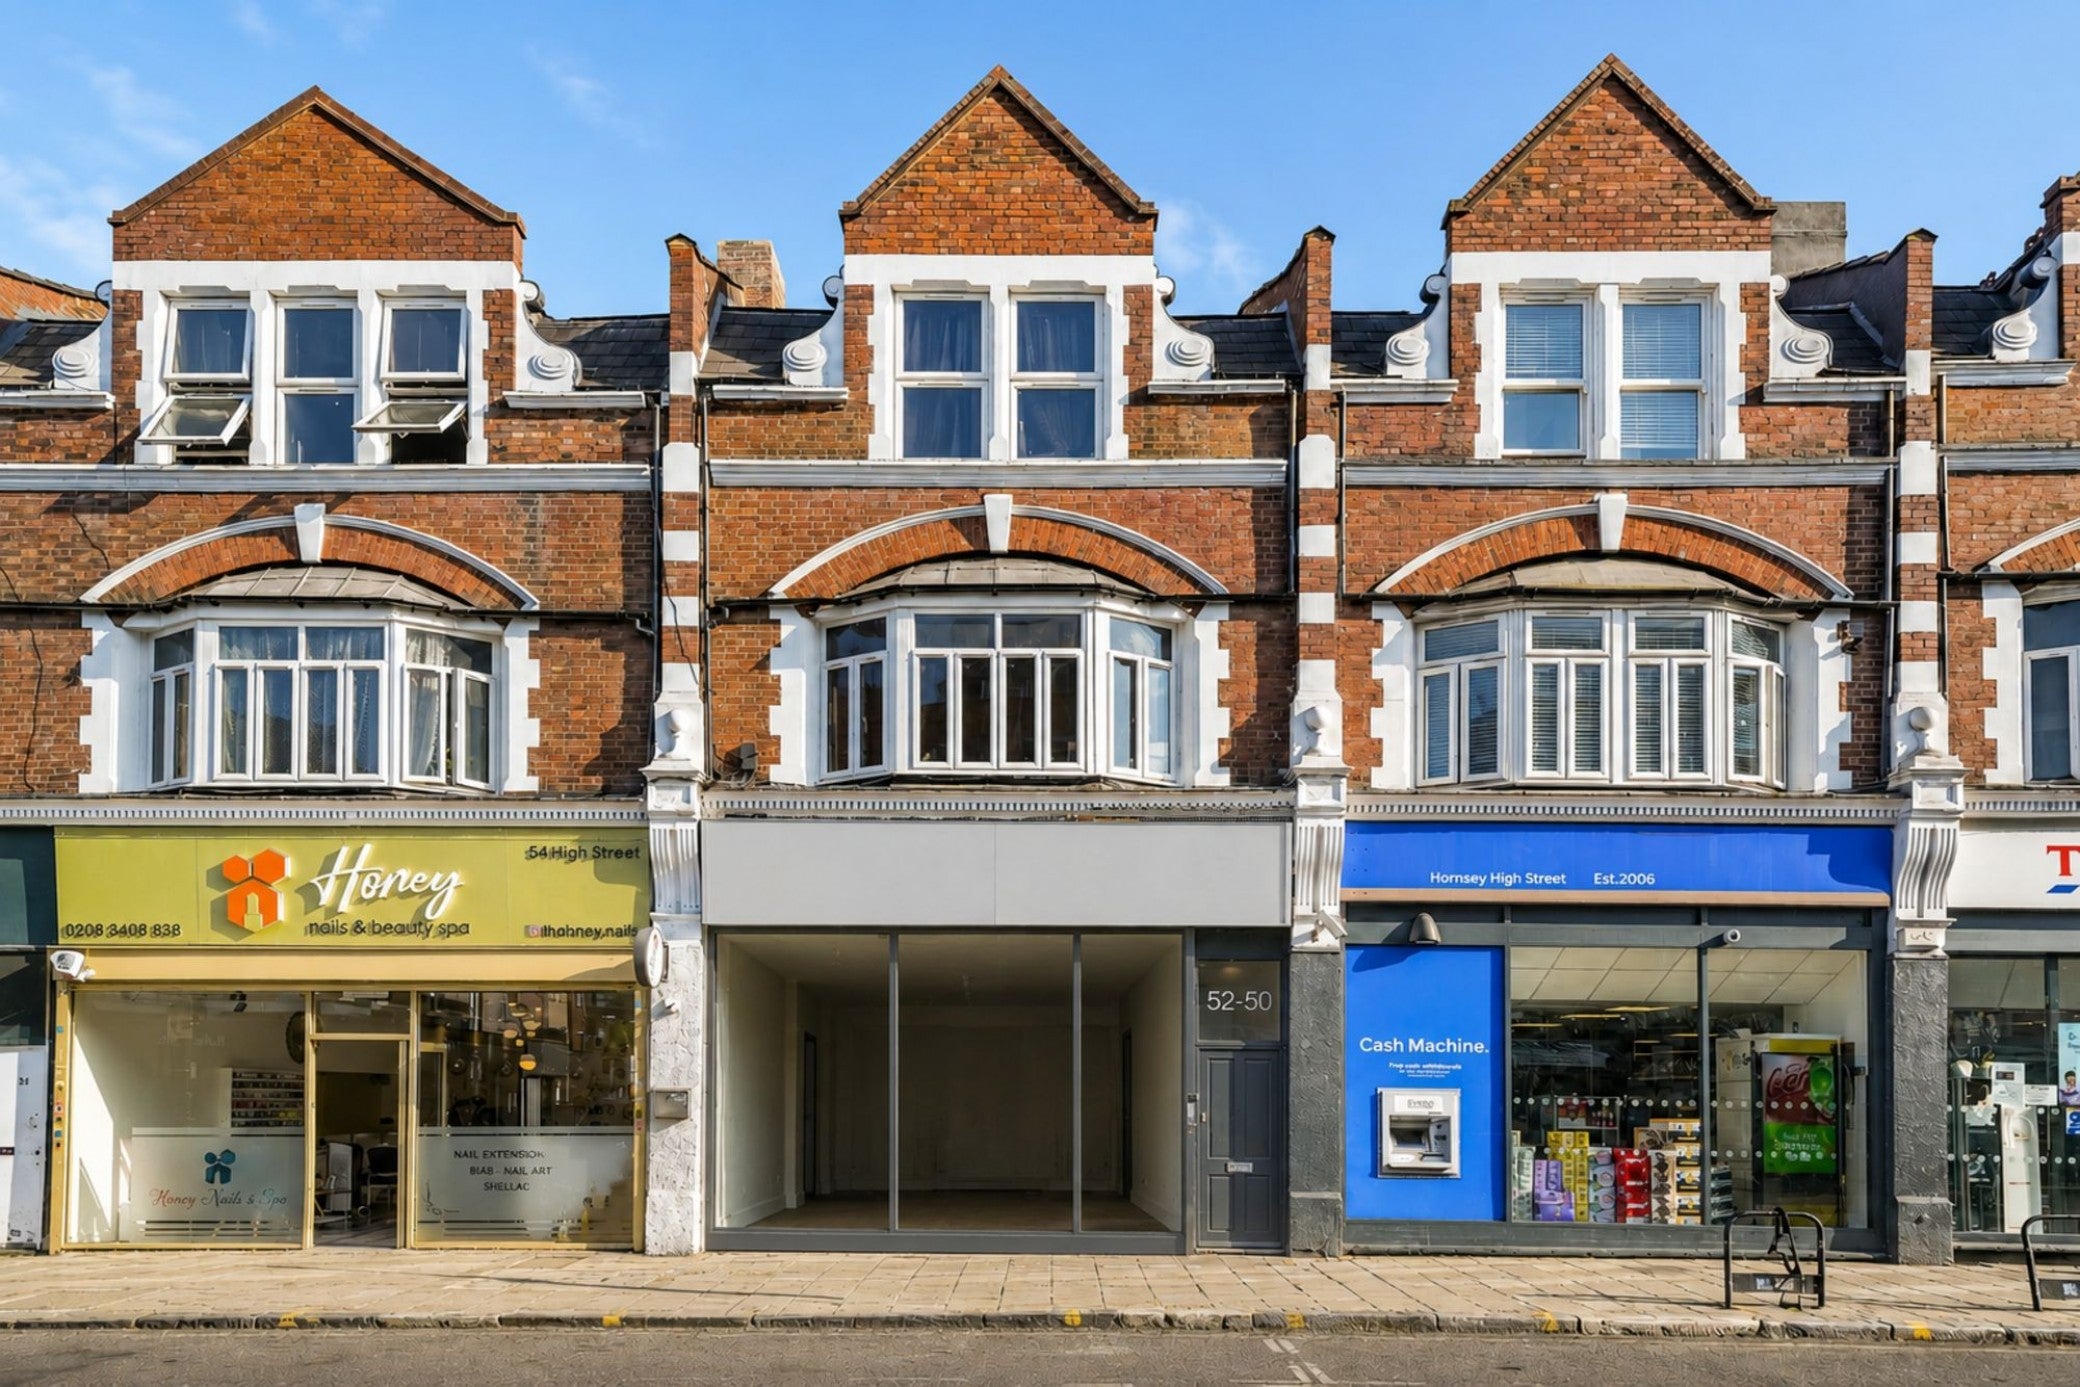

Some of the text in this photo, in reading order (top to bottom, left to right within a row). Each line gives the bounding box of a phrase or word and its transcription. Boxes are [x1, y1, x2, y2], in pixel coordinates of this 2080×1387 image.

[528, 845, 640, 862] 54 High Street
[309, 842, 465, 920] Honey
[1430, 872, 1655, 887] Hornsey High Street Est.2006
[65, 923, 181, 937] 0208 3408 838
[308, 919, 470, 938] nails & beauty spa
[1206, 990, 1272, 1012] 52-50
[1359, 1037, 1490, 1053] Cash Machine.
[454, 1150, 479, 1159] NAIL
[503, 1167, 528, 1175] NAIL
[531, 1167, 552, 1175] ART
[483, 1182, 530, 1191] SHELLAC
[201, 1188, 242, 1207] Nails
